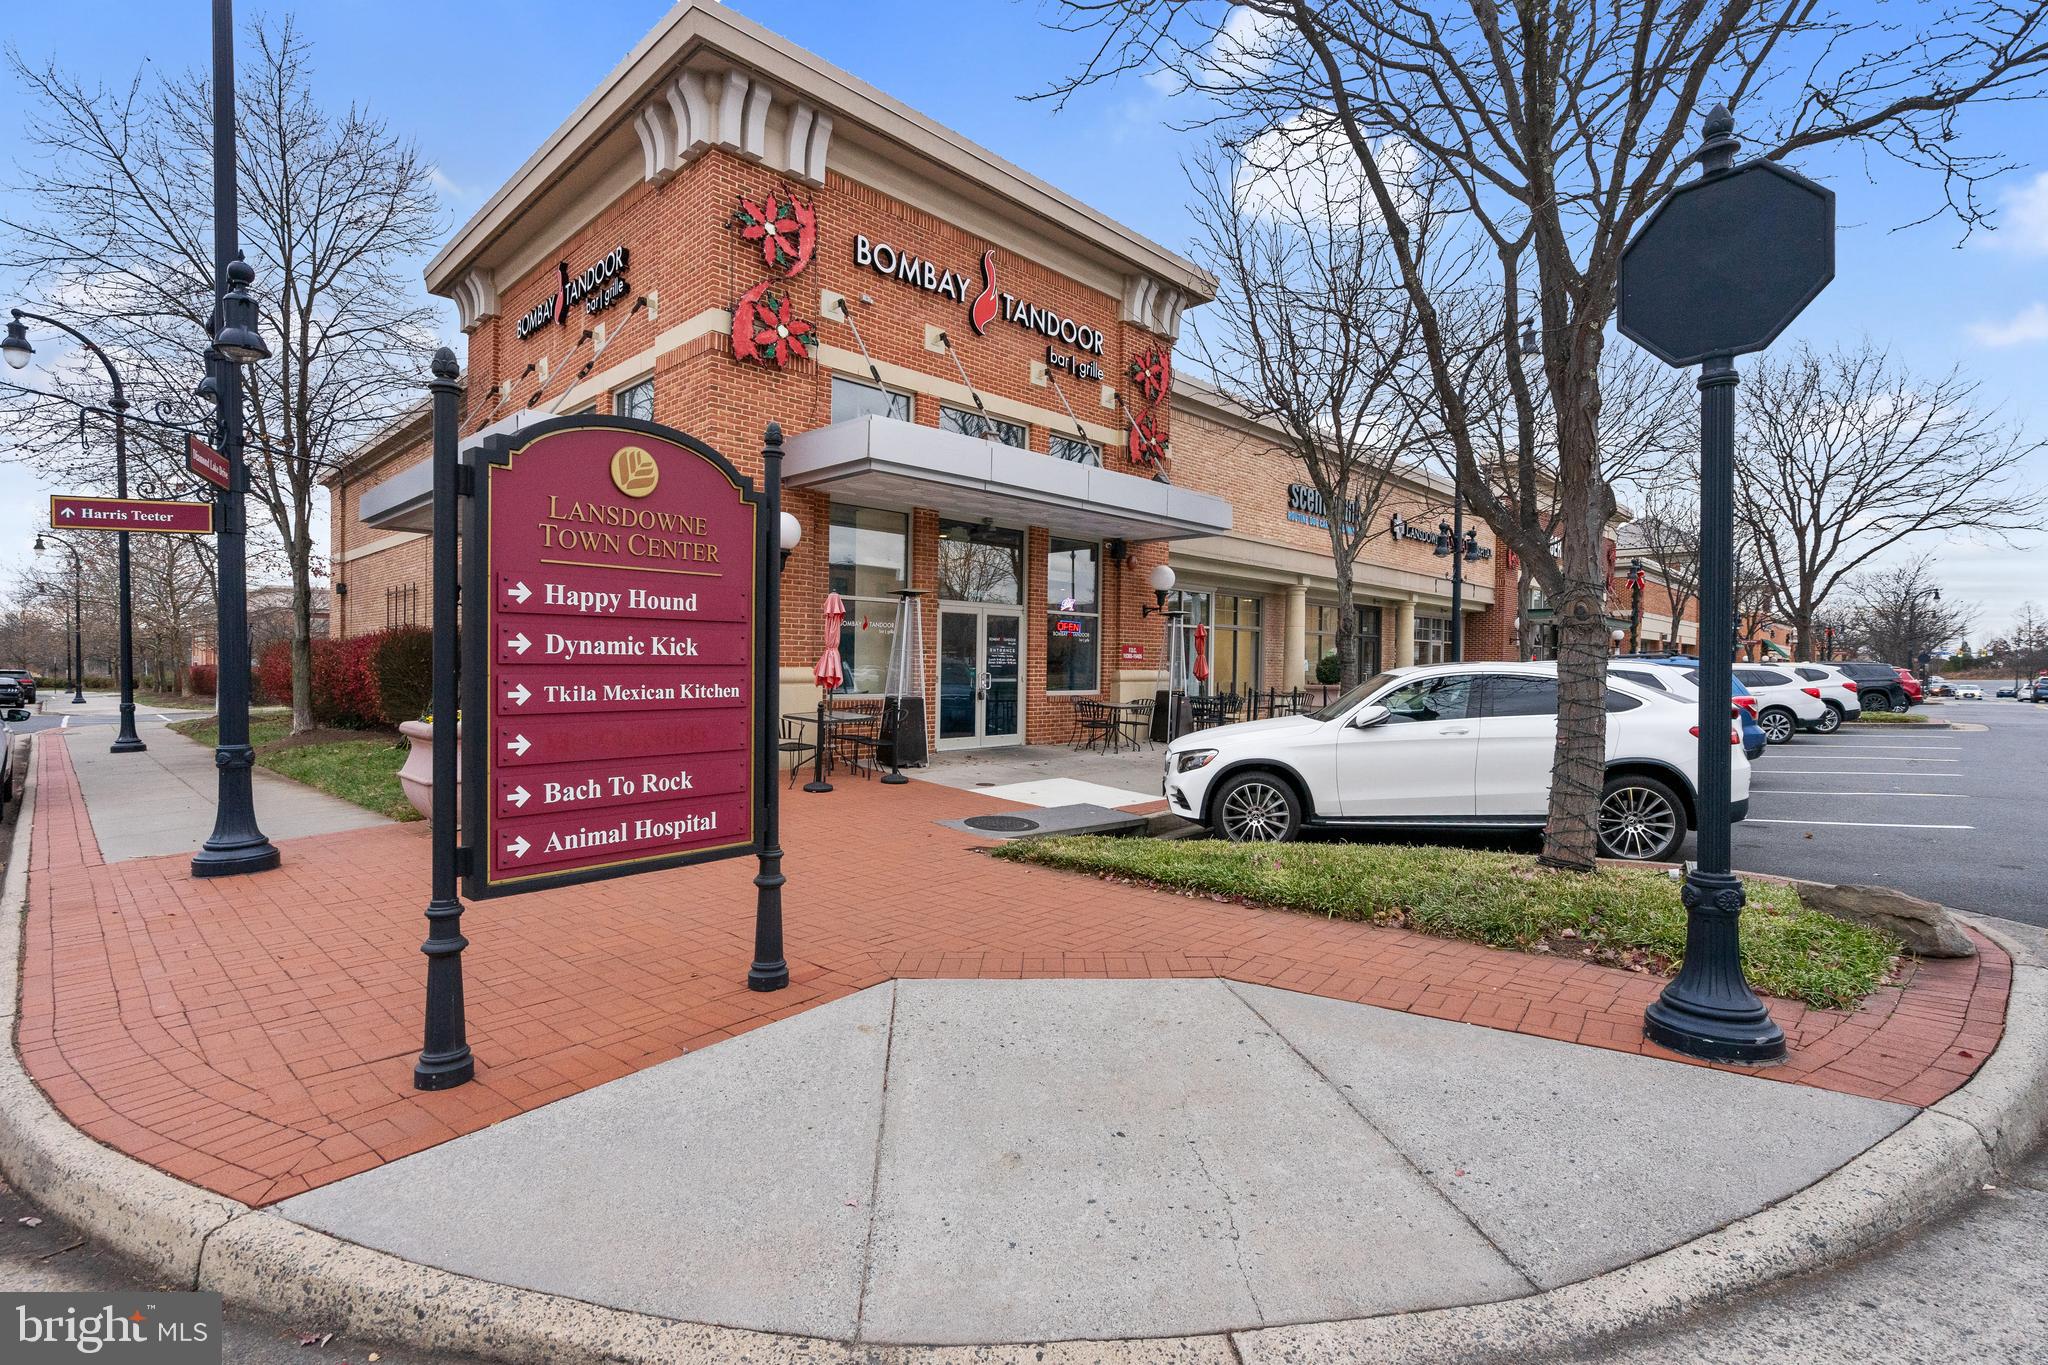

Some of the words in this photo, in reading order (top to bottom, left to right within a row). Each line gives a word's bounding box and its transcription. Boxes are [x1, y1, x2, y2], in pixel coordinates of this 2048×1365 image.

[516, 294, 556, 339] BOMBAY
[564, 246, 624, 305] TANDOOR
[586, 296, 599, 315] bar
[604, 280, 624, 306] grille
[857, 234, 971, 303] BOMBAY
[1002, 292, 1105, 355] TANDOOR
[1050, 346, 1069, 369] bar
[1079, 360, 1104, 380] grille
[81, 507, 128, 521] Harris
[132, 510, 174, 523] Teeter
[548, 495, 708, 536] LANSDOWNE
[538, 523, 621, 553] TOWN
[627, 534, 720, 563] CENTER
[1406, 525, 1438, 545] LANSDOW
[544, 583, 622, 613] Happy
[627, 588, 698, 612] Hound
[1057, 622, 1079, 631] OPEN
[544, 633, 645, 660] Dynamic
[650, 636, 699, 657] Kick
[543, 684, 597, 703] Tkila
[602, 684, 675, 702] Mexican
[680, 683, 740, 700] Kitchen
[543, 779, 601, 804] Bach
[608, 775, 635, 796] To
[641, 770, 693, 793] Rock
[543, 822, 627, 854] Animal
[634, 811, 718, 841] Hospital
